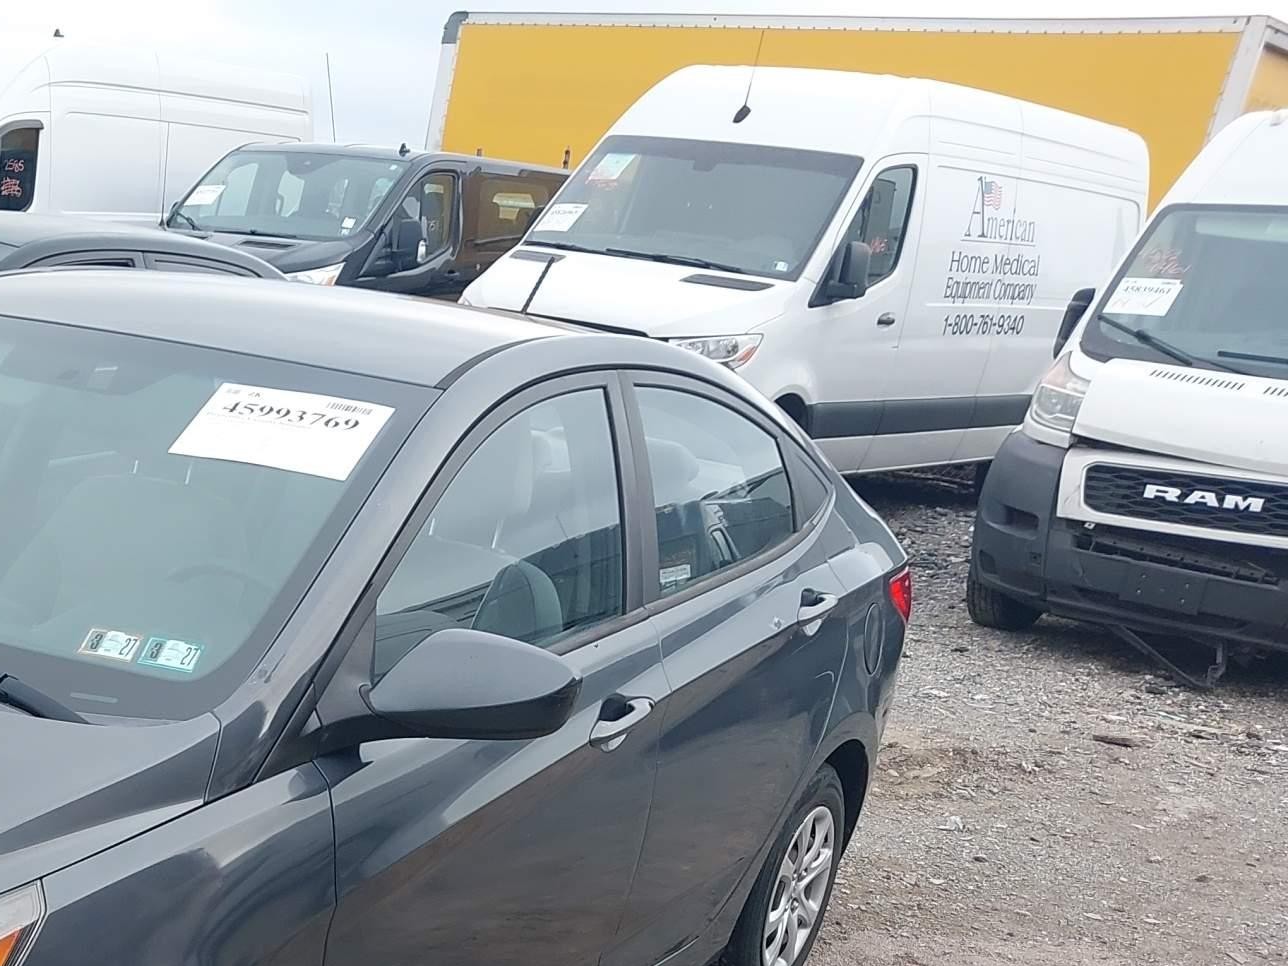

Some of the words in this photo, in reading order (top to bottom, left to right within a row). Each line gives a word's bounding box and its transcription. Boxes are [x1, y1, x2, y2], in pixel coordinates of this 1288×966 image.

[964, 176, 1036, 243] American
[949, 251, 990, 275] Home
[991, 253, 1040, 277] Medical
[944, 277, 994, 304] Equipment
[993, 278, 1037, 305] Company
[942, 313, 1025, 337] 1-800-761-9340
[223, 400, 360, 431] 45993769
[1143, 484, 1265, 512] RAM
[90, 633, 104, 650] 3
[118, 637, 139, 657] 27
[149, 642, 163, 659] 3
[179, 646, 201, 666] 27
